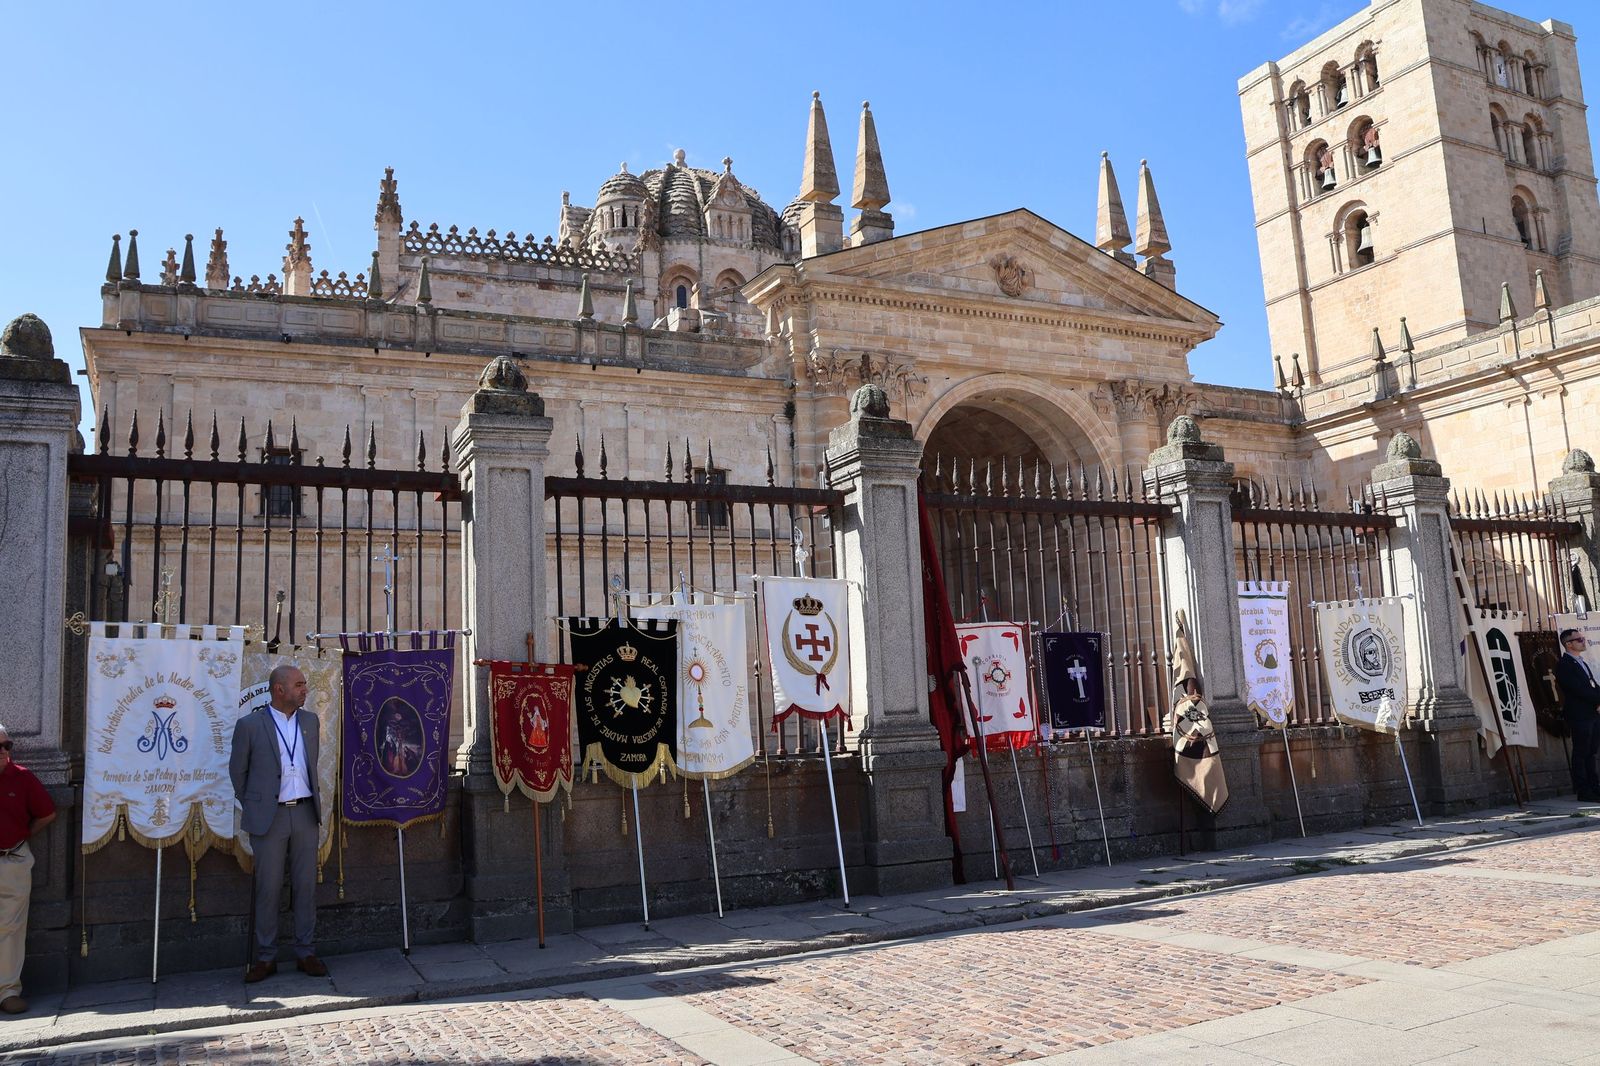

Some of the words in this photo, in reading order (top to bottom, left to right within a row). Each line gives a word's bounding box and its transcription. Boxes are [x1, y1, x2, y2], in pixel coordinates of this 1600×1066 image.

[1332, 613, 1361, 687] HERMANDAD
[1367, 613, 1403, 684] ENITENCIAL
[584, 654, 614, 693] ANGUSTIAS
[641, 656, 659, 675] REAL
[255, 687, 263, 696] DE
[659, 675, 668, 715] COFRADIA
[584, 696, 594, 712] LAS
[97, 735, 114, 755] Real
[145, 675, 155, 689] de
[157, 671, 164, 684] la
[168, 671, 194, 691] Madre
[193, 688, 210, 701] del
[202, 699, 217, 719] Amor
[591, 714, 601, 726] DE
[600, 725, 628, 743] MADRE
[632, 727, 658, 744] NUESTRA
[620, 753, 648, 762] ZAMORA
[134, 769, 141, 782] de
[143, 769, 155, 782] San
[179, 769, 191, 782] San
[144, 784, 176, 795] ZAMORA
